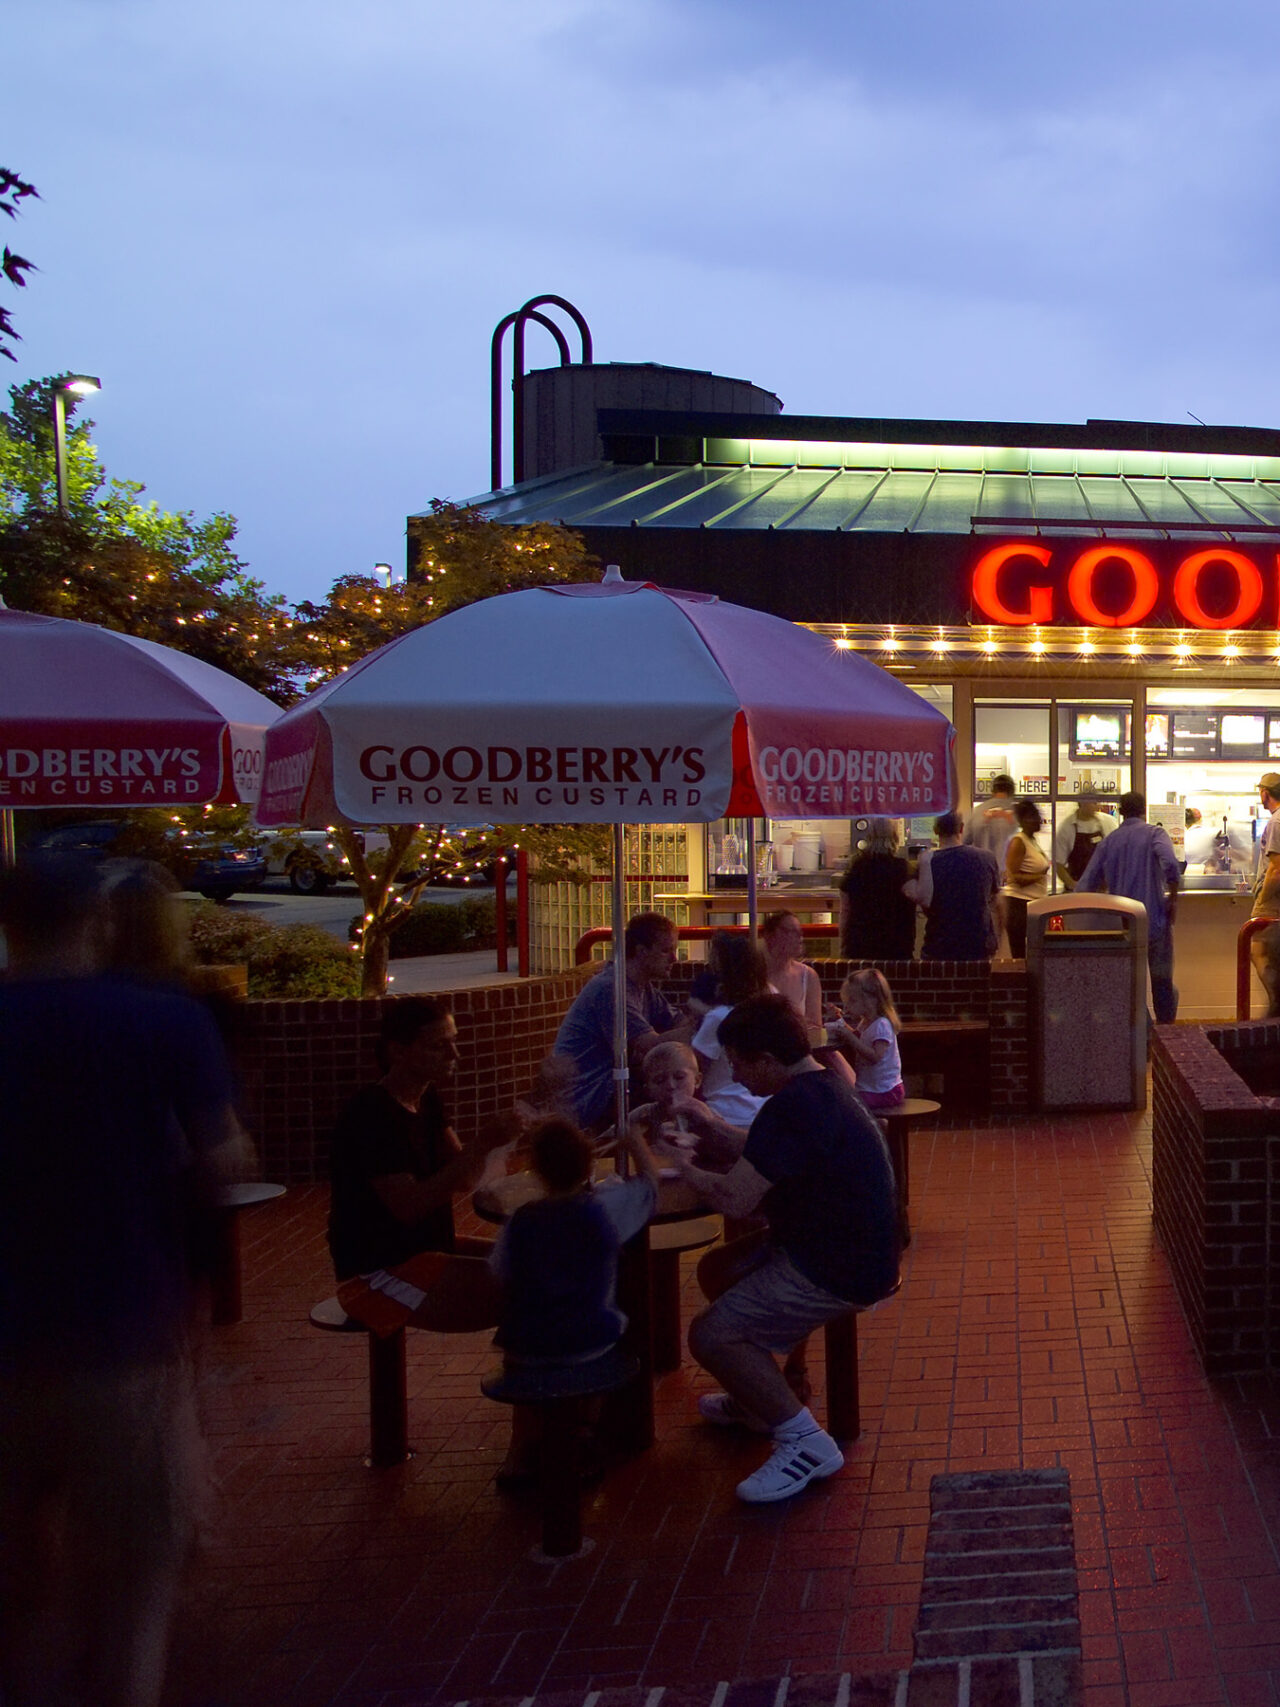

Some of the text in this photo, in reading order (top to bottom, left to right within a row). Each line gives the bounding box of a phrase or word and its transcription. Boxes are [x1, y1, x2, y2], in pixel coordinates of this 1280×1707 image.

[0, 747, 201, 777] DBERRY'S
[359, 745, 706, 784] GOODBERRY'S
[758, 746, 935, 783] GOODBERRY'S
[51, 779, 200, 794] CUSTARD
[766, 785, 933, 803] FROZEN CUSTARD
[1019, 780, 1048, 793] HERE
[1073, 780, 1116, 793] PICK UP
[371, 786, 702, 807] FROZEN CUSTARD
